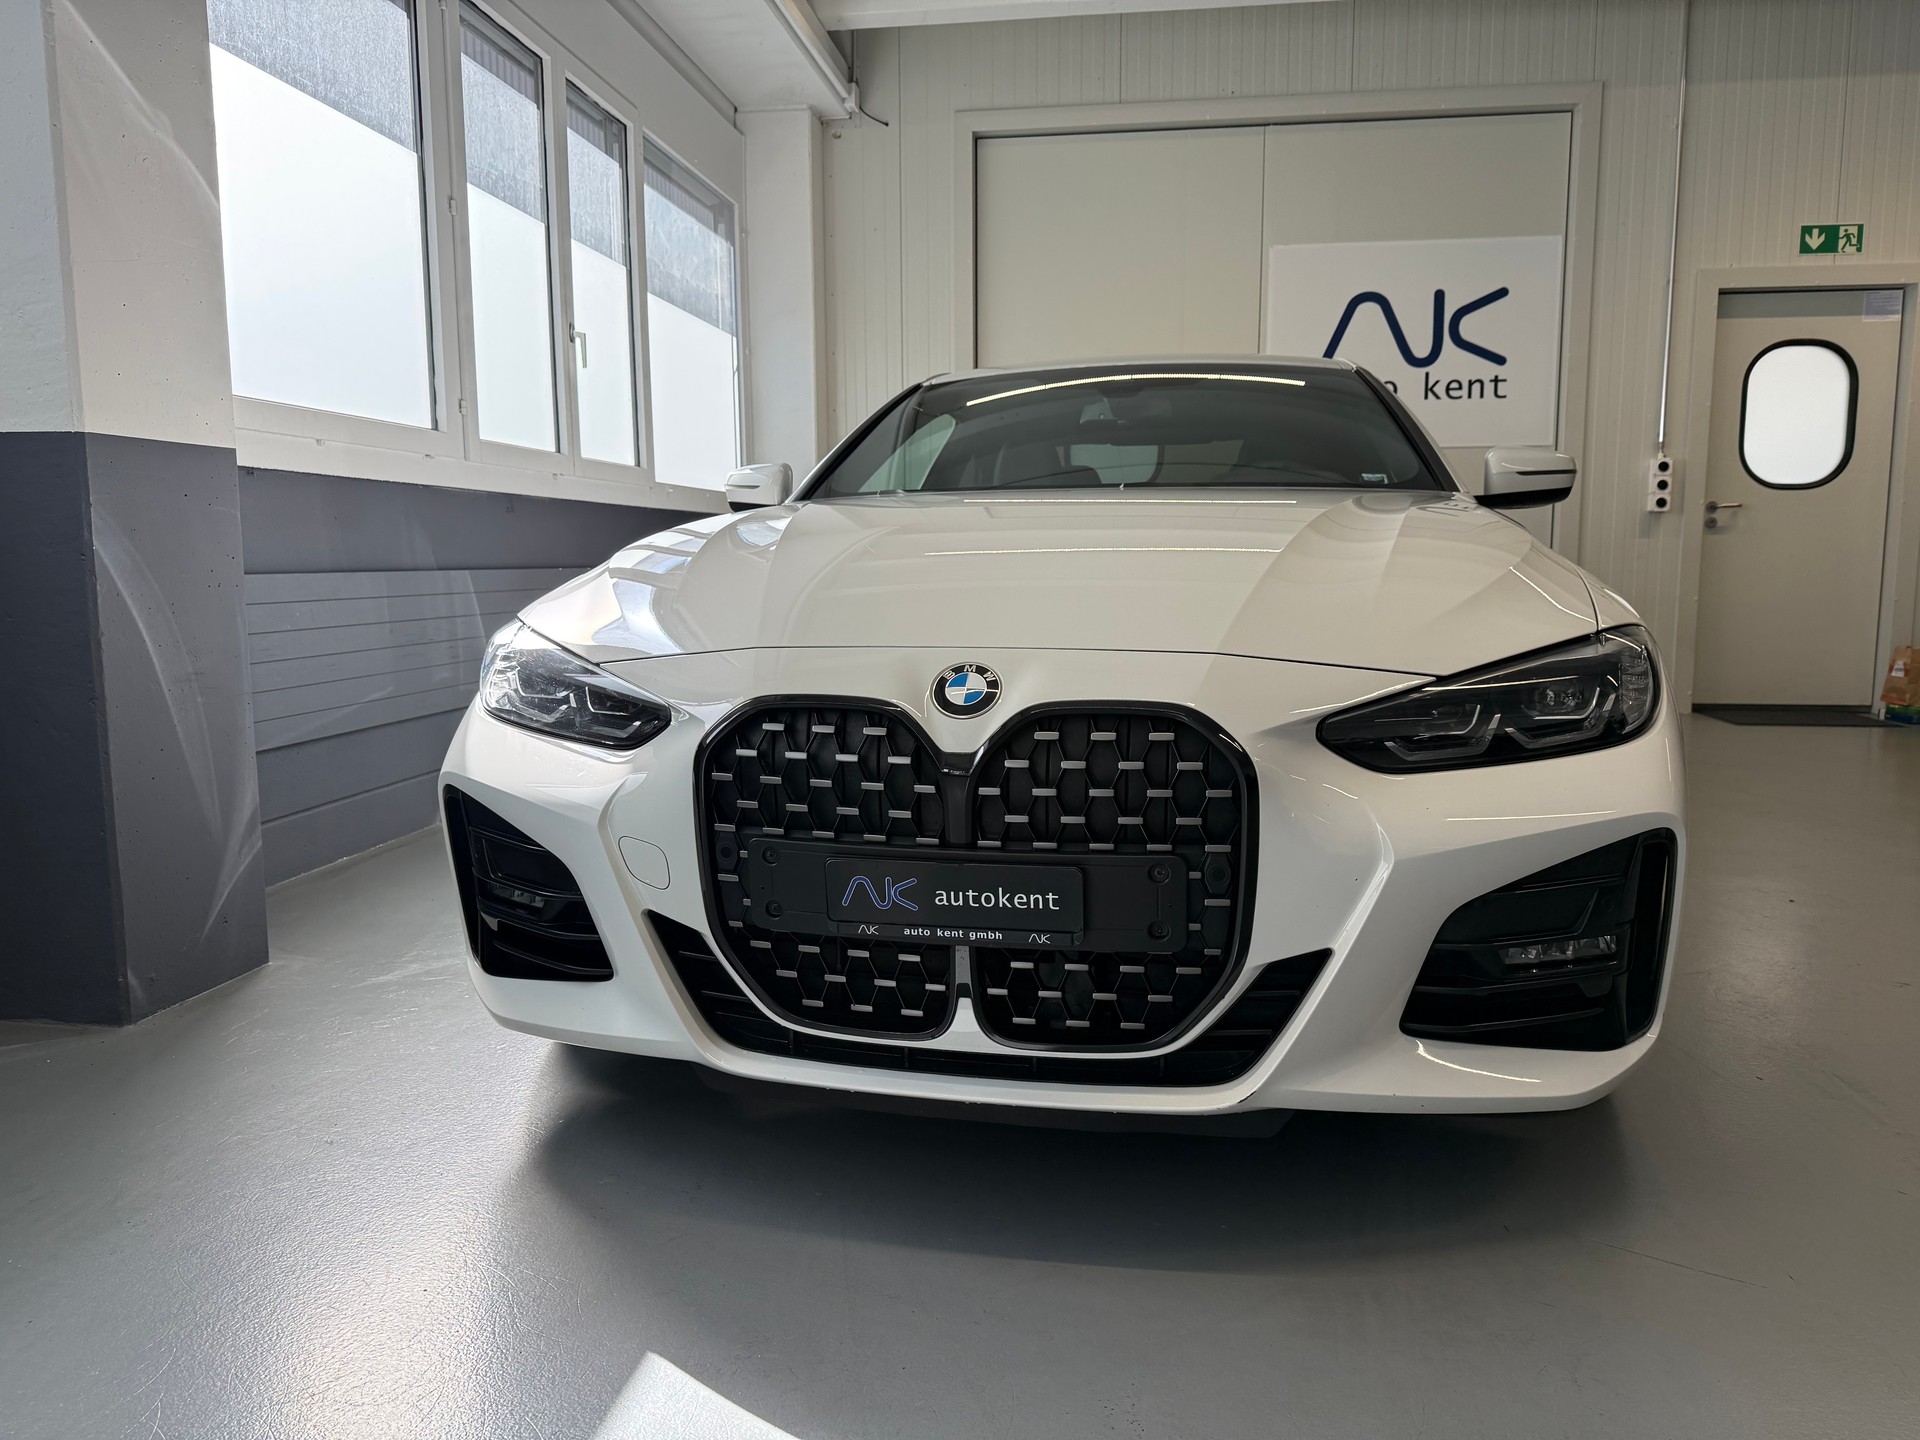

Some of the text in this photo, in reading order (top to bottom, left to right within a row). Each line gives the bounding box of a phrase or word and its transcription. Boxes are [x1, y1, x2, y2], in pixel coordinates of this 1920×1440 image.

[1423, 371, 1507, 400] kent
[943, 664, 996, 682] BMW
[934, 887, 1060, 910] autokent
[903, 927, 931, 936] auto
[936, 928, 964, 938] kent
[969, 931, 1003, 941] gmbh
